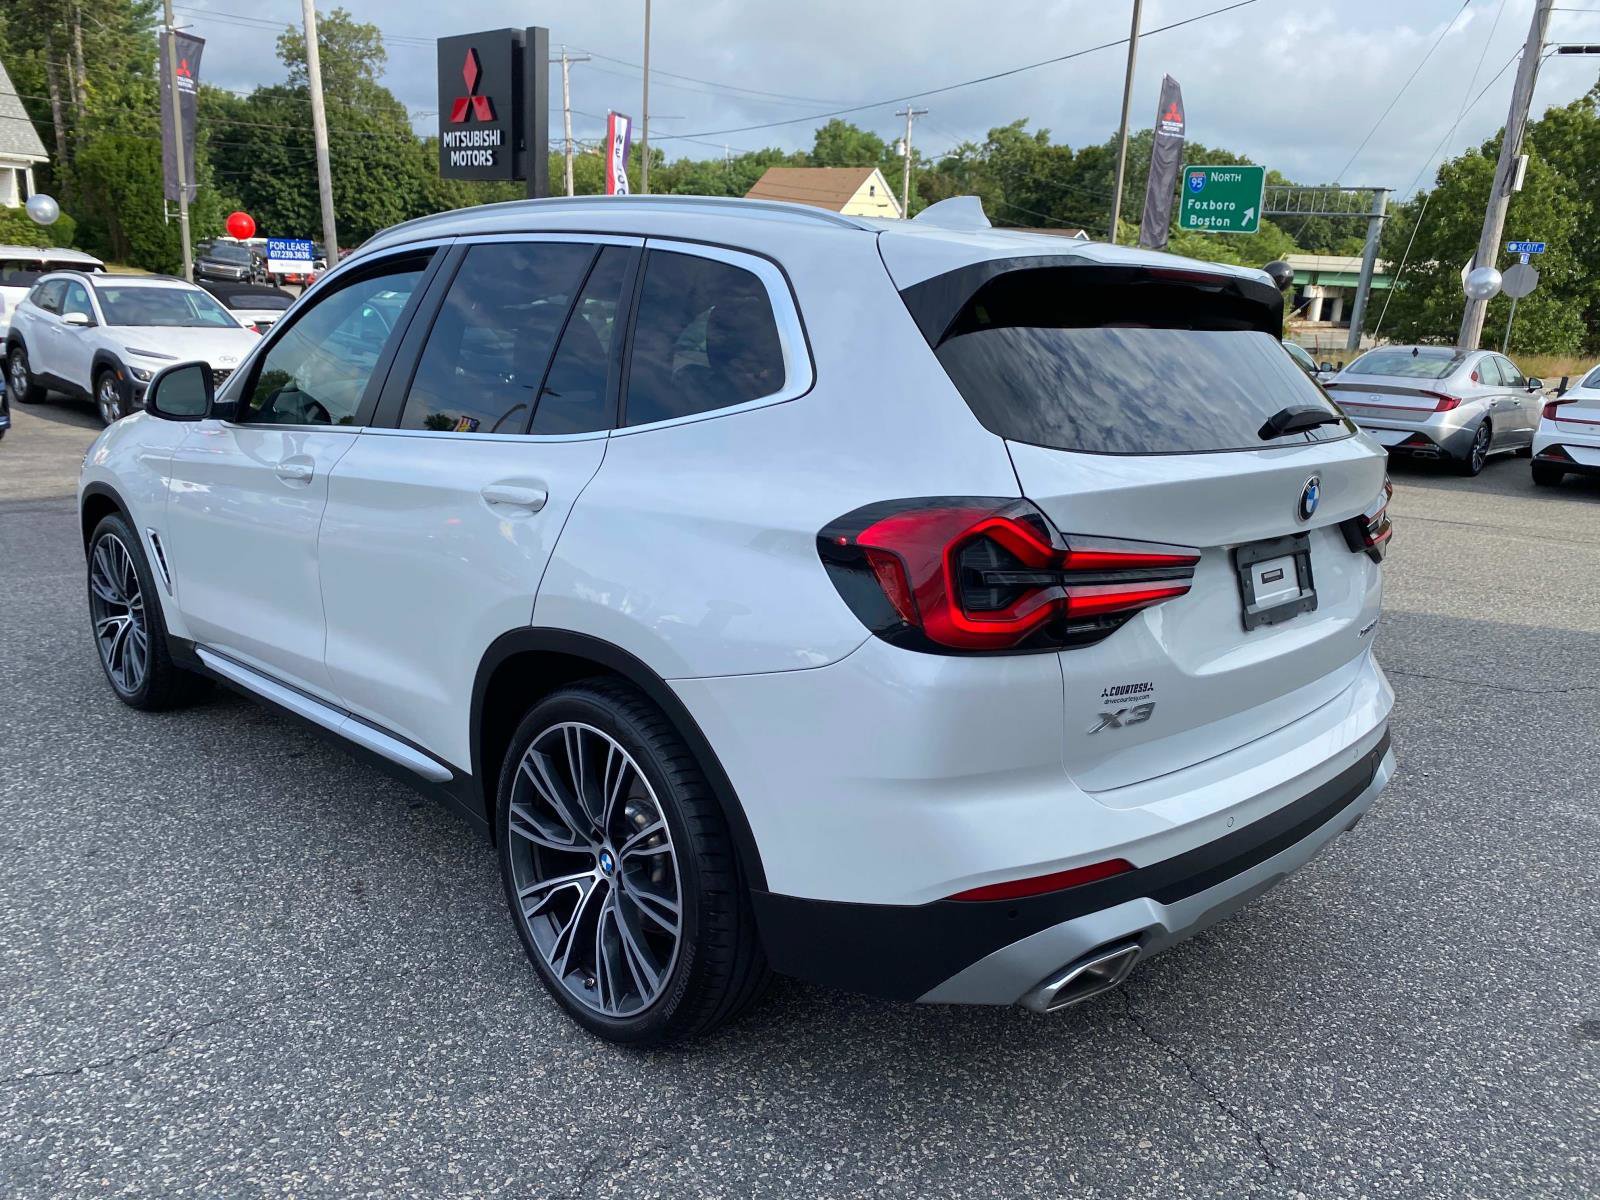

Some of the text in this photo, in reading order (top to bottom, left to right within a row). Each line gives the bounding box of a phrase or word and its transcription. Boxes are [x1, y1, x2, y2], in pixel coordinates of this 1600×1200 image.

[443, 129, 501, 148] MITSUBISHI
[450, 149, 494, 167] MOTORS
[1210, 171, 1242, 182] NORTH
[1191, 177, 1203, 188] 95
[1187, 199, 1236, 210] Foxboro
[1189, 214, 1231, 226] Boston
[269, 241, 310, 251] FOR LEASE
[1517, 243, 1538, 252] SCOTT
[1087, 701, 1156, 734] X3
